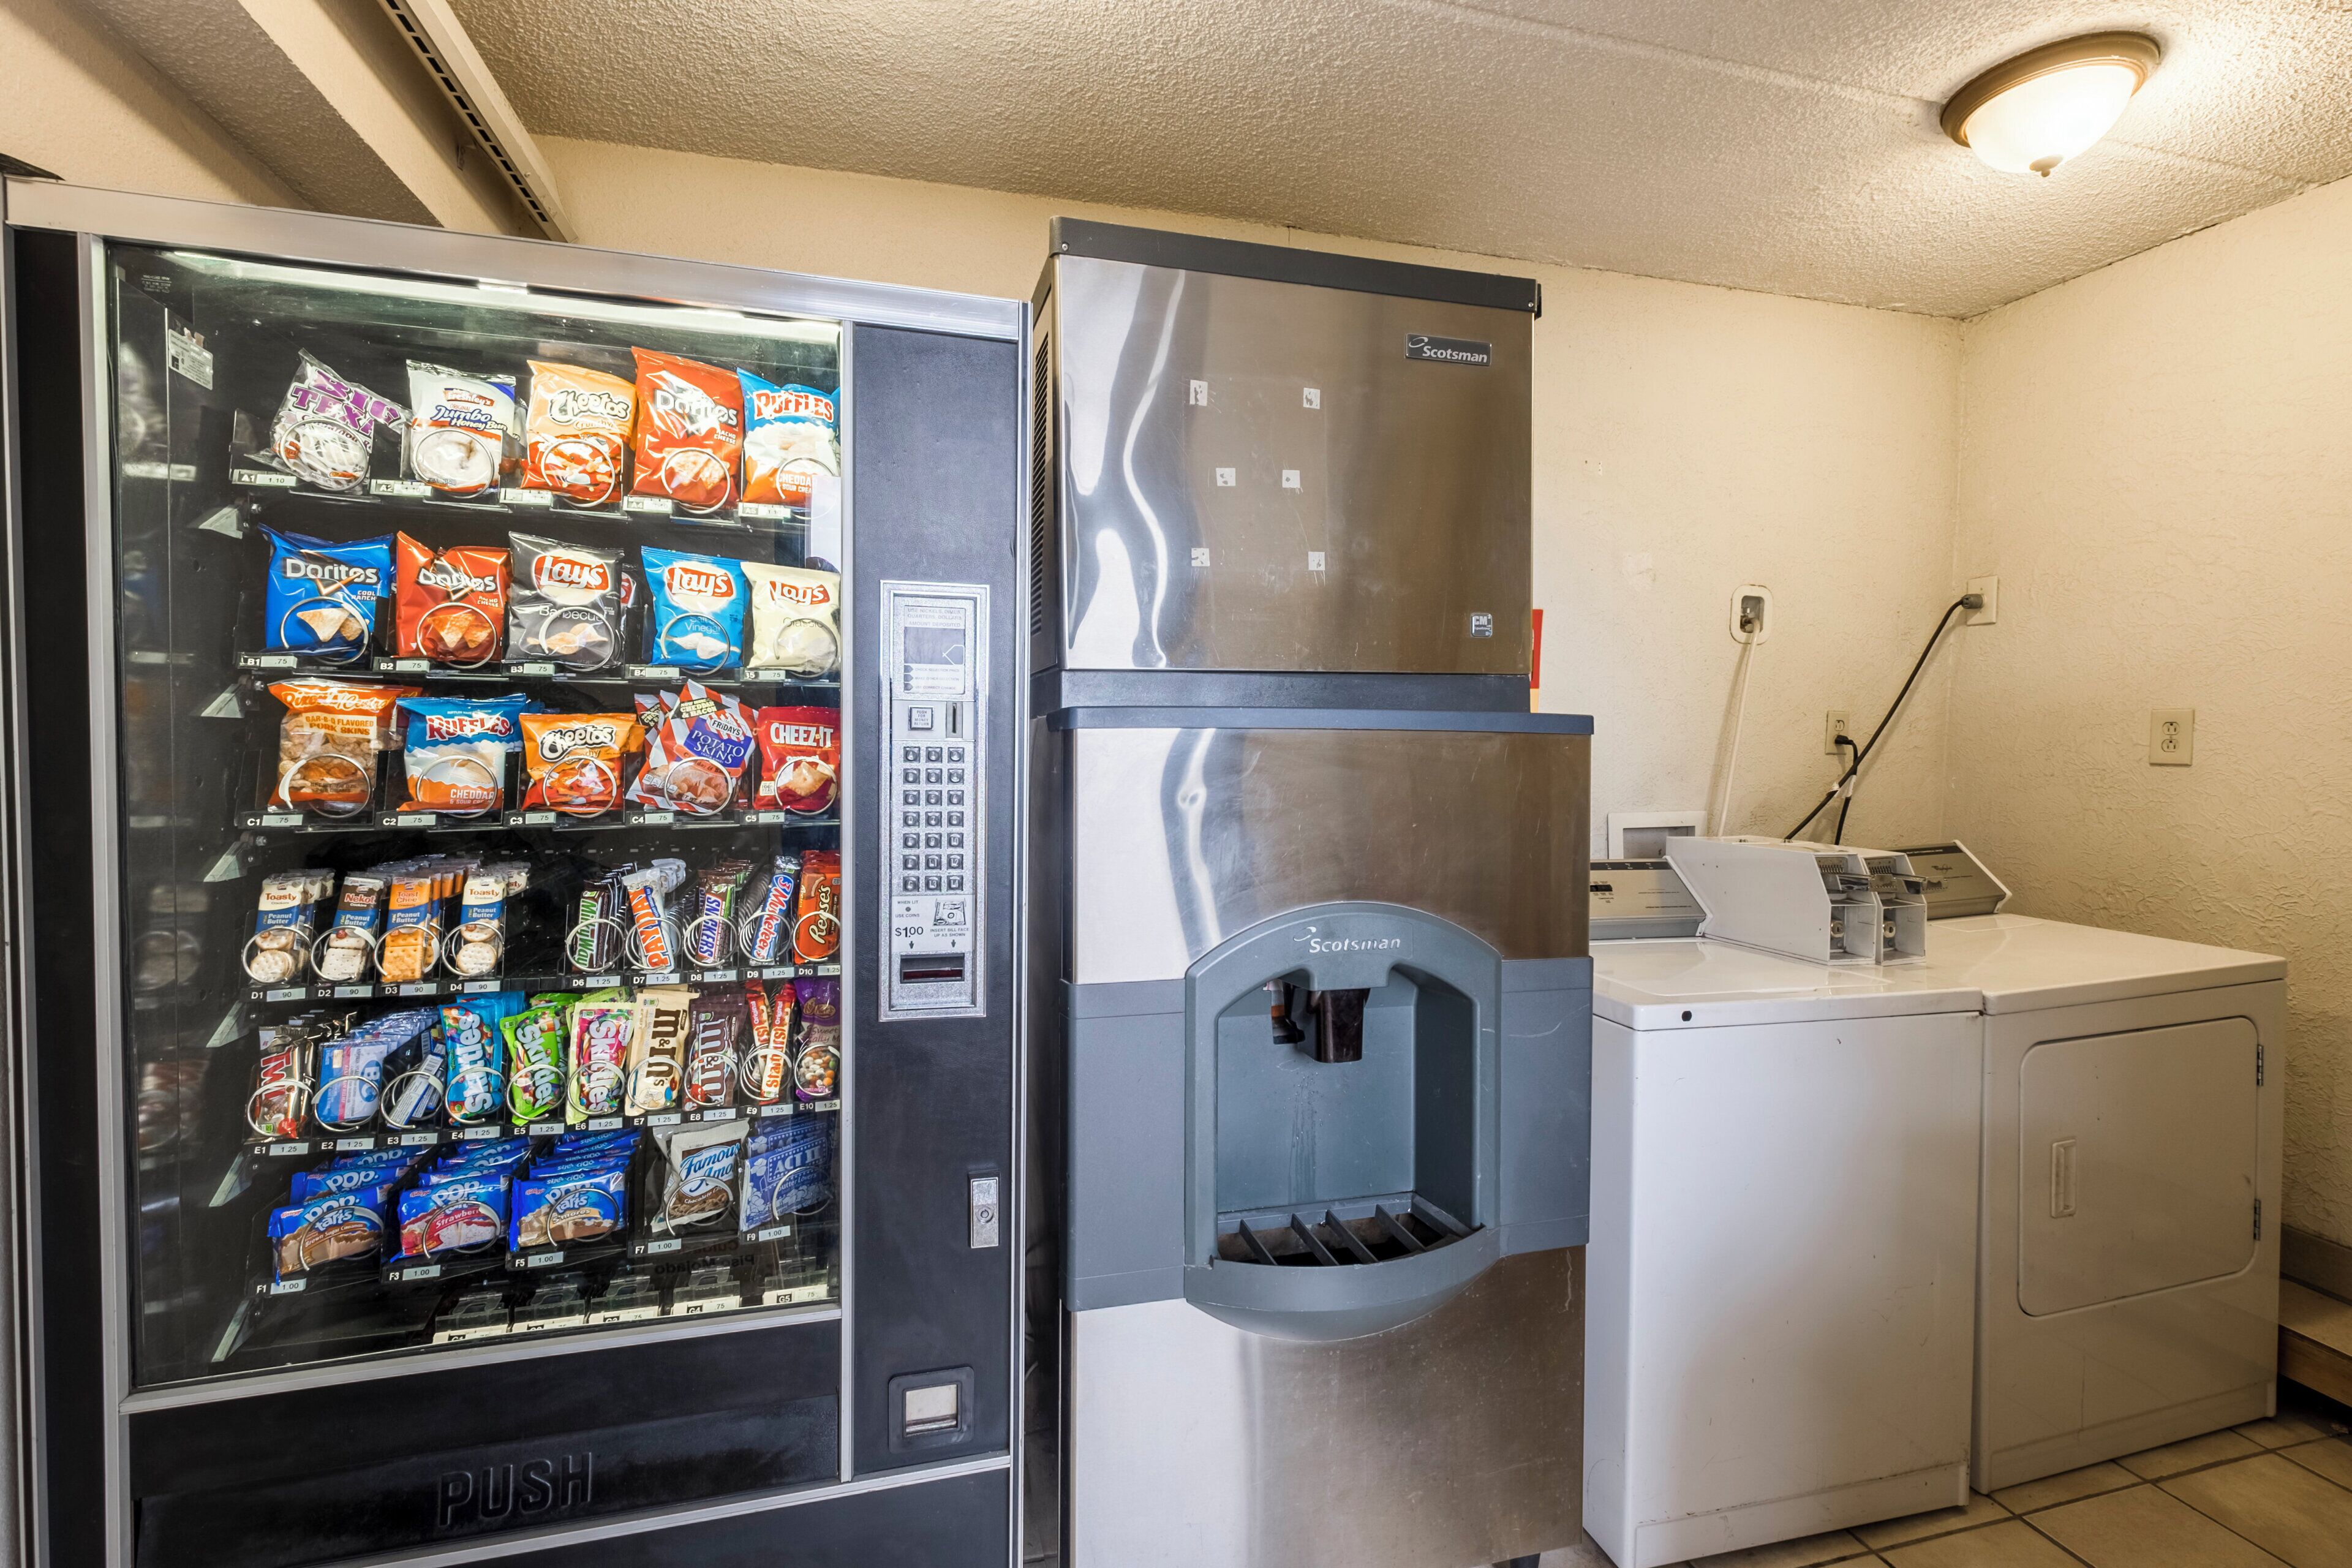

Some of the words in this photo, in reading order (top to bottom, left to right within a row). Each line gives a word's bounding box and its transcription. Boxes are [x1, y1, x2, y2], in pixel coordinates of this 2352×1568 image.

[1422, 345, 1488, 363] Scotsman
[309, 369, 400, 426] BIG
[550, 390, 630, 423] Cheetos
[755, 391, 834, 421] RUFFLES
[292, 386, 375, 436] TEXA
[431, 405, 492, 421] Jumbo
[451, 419, 486, 431] Honey
[486, 421, 507, 431] Bun
[714, 434, 736, 445] CHEESE
[241, 474, 255, 483] A1
[779, 473, 813, 486] CHEDDA
[286, 558, 378, 584] Doritos
[419, 567, 497, 592] Doritos
[540, 556, 604, 589] Lay's
[671, 567, 728, 597] Lay's
[775, 581, 825, 606] Lay's
[539, 605, 605, 621] Babecue
[685, 623, 721, 634] Vinegar
[680, 701, 715, 712] CHEDDAR
[690, 706, 717, 717] BACON
[306, 716, 336, 725] BAR-B-Q
[337, 718, 374, 727] FLAVORED
[309, 723, 337, 732] PORK
[341, 726, 371, 735] SKINS
[426, 715, 513, 741] RUFFLES
[540, 725, 616, 761] Cheetos
[692, 730, 744, 757] POTATO
[694, 741, 734, 764] SKINS
[450, 789, 495, 799] CHEDDAR
[469, 888, 500, 897] Toasty
[777, 877, 791, 891] 3
[265, 893, 297, 902] Toasty
[345, 893, 376, 904] Nekot
[753, 889, 788, 960] Musketeers
[809, 884, 831, 944] Reese's
[628, 887, 672, 968] PAYDAY
[698, 895, 721, 962] SNICKERS
[895, 926, 924, 938] $1.00
[1308, 938, 1401, 953] Scotsman
[751, 1001, 760, 1024] Original
[775, 1001, 783, 1024] Original
[262, 1046, 293, 1100] TWI
[455, 1014, 493, 1113] Skittles
[516, 1024, 555, 1109] Skittles
[589, 1020, 617, 1111] Skittles
[680, 1142, 741, 1182] Famous
[774, 1152, 803, 1175] ACT
[805, 1145, 821, 1163] II
[689, 1163, 734, 1193] Amo
[797, 1172, 817, 1183] Lovers
[684, 1192, 712, 1205] Chocolate
[435, 1209, 479, 1229] Strawber
[552, 1209, 590, 1224] S'mores
[305, 1235, 323, 1247] Brown
[325, 1228, 339, 1237] Sugar
[257, 1284, 267, 1294] F1
[438, 1452, 592, 1528] PUSH
